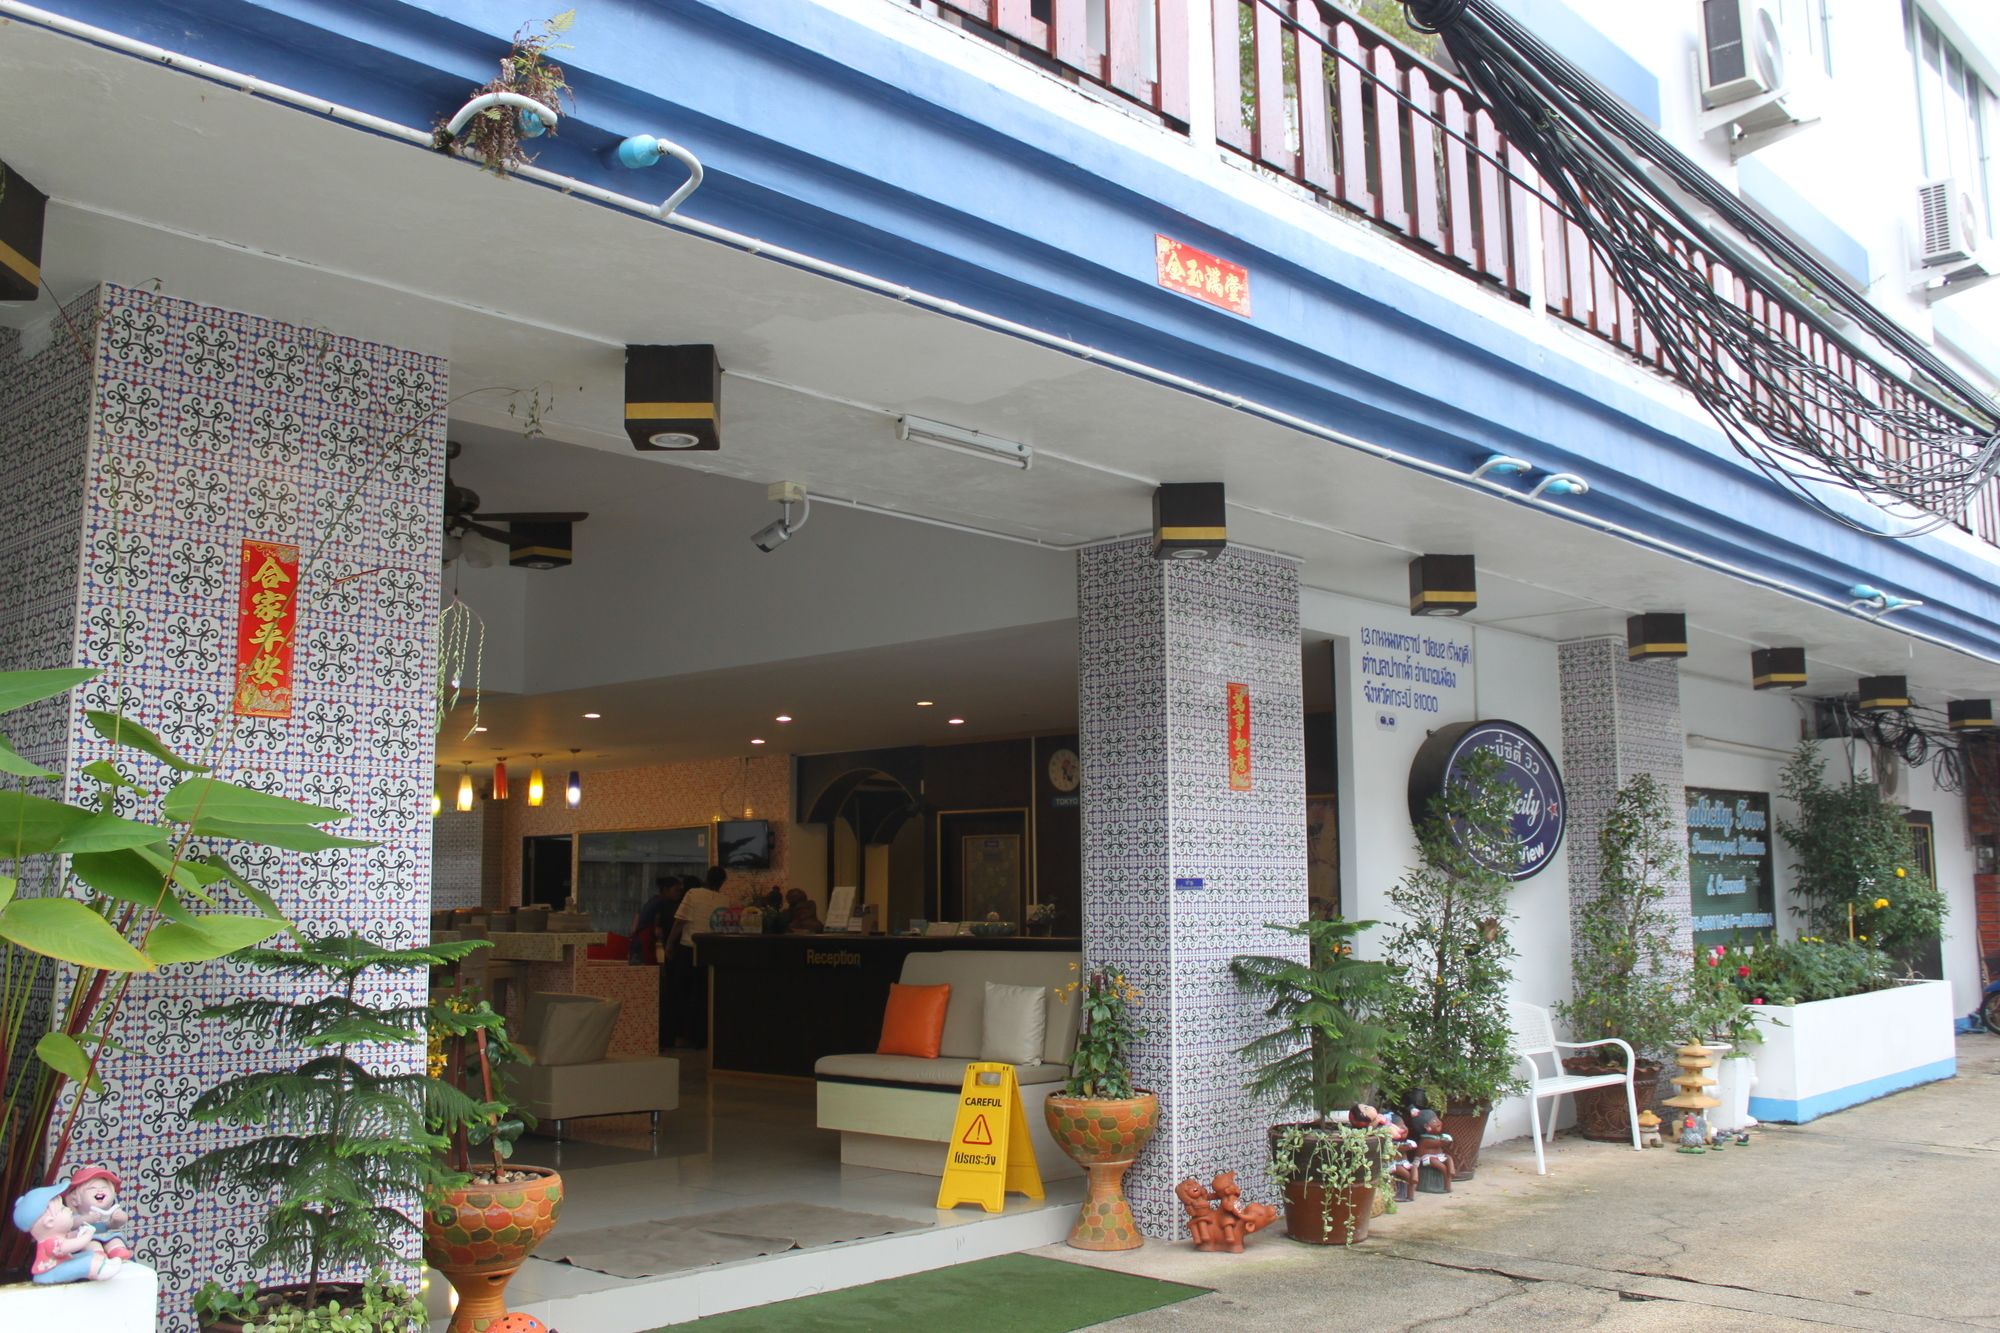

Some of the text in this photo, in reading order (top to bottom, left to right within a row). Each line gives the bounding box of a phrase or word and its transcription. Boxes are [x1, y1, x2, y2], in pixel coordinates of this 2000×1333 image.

[249, 556, 290, 687] 合家平安
[1413, 692, 1438, 713] 81000
[1525, 751, 1540, 775] วิว
[807, 949, 862, 968] Reception
[965, 1097, 1002, 1107] CAREFUL
